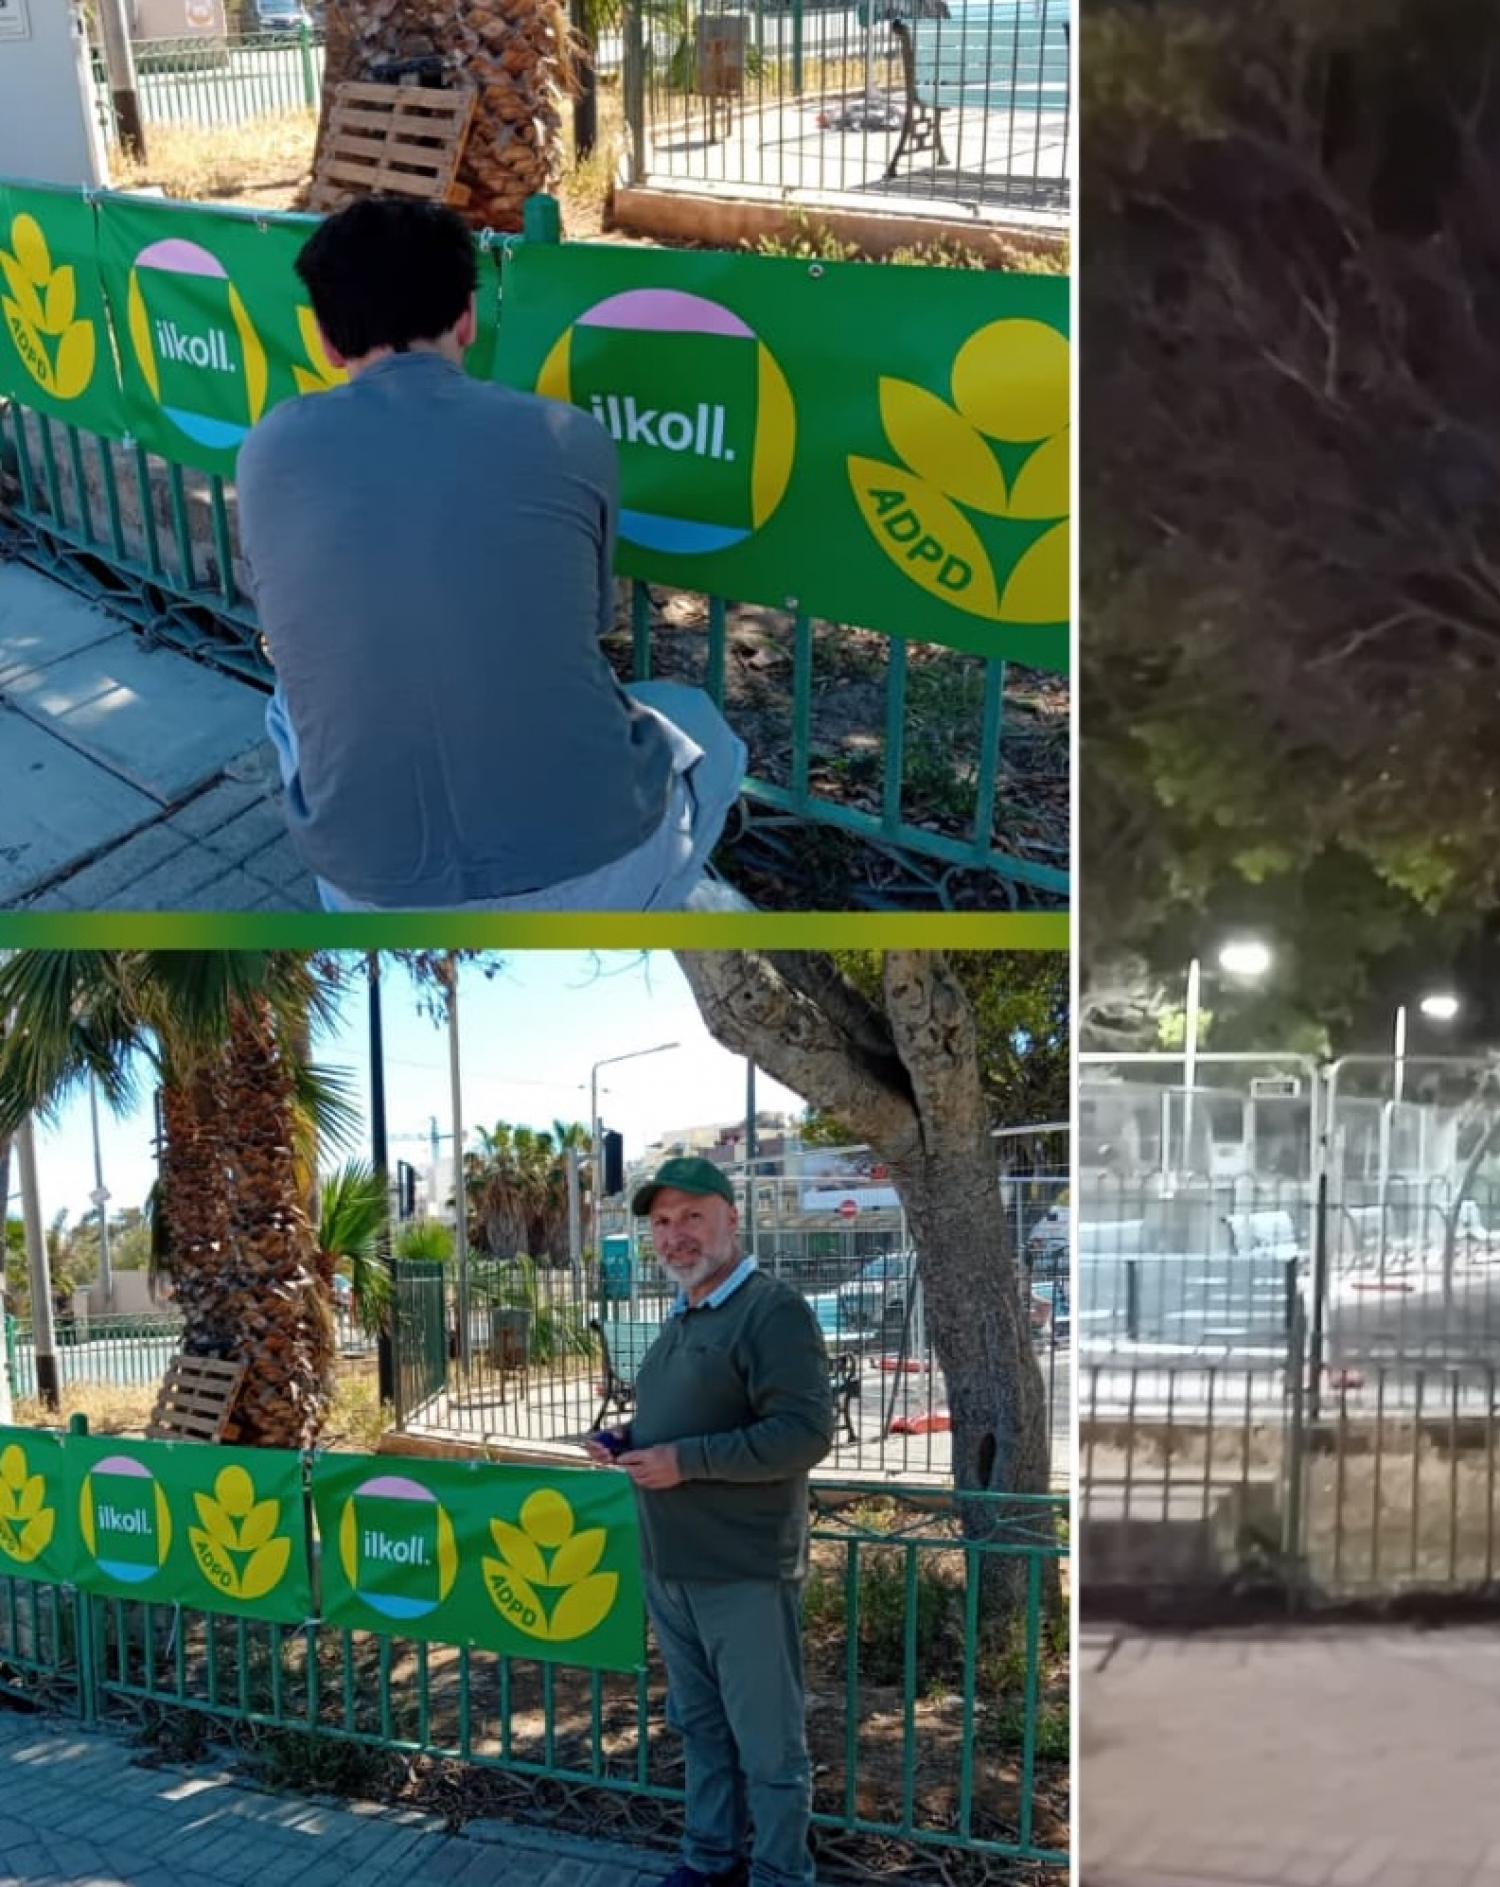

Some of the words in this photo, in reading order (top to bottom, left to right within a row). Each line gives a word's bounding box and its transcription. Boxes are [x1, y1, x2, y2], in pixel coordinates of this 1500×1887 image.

[10, 317, 47, 380] ADPD
[155, 320, 236, 372] ilkoll.
[591, 396, 736, 460] ilkoll.
[868, 487, 973, 592] ADPD
[98, 1505, 152, 1534] ilkoll.
[195, 1540, 232, 1588] ADPD
[363, 1530, 431, 1566] ilkoll.
[490, 1574, 537, 1628] ADPD
